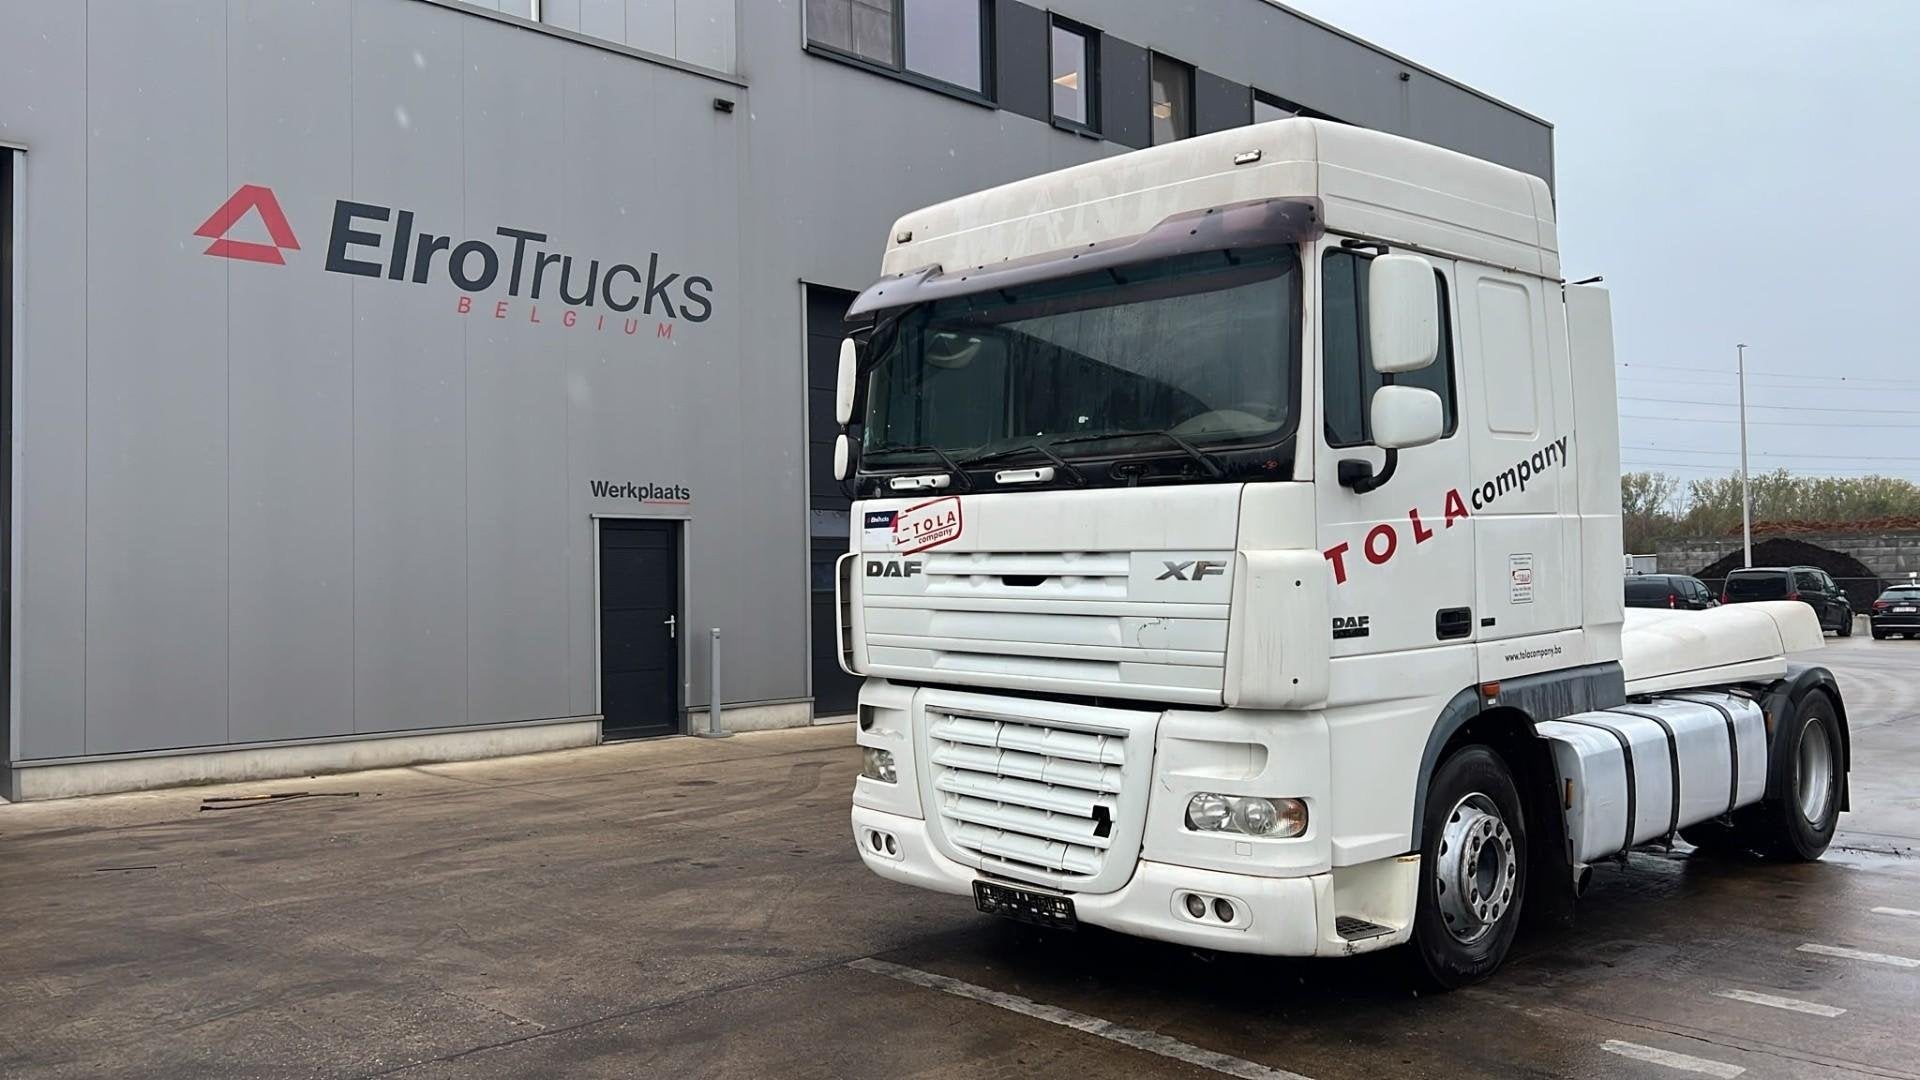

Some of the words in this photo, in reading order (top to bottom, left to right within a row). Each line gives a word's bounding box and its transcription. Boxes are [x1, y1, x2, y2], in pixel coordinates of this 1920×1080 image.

[324, 199, 714, 323] ElroTrucks
[457, 295, 674, 340] BELGIUM
[590, 480, 690, 502] Werkplaats
[1323, 487, 1470, 586] TOLA
[1471, 435, 1568, 510] company
[913, 510, 956, 535] TOLA
[918, 528, 953, 545] company
[866, 560, 922, 578] DAF
[1155, 560, 1228, 581] XF
[1332, 615, 1370, 629] DAF
